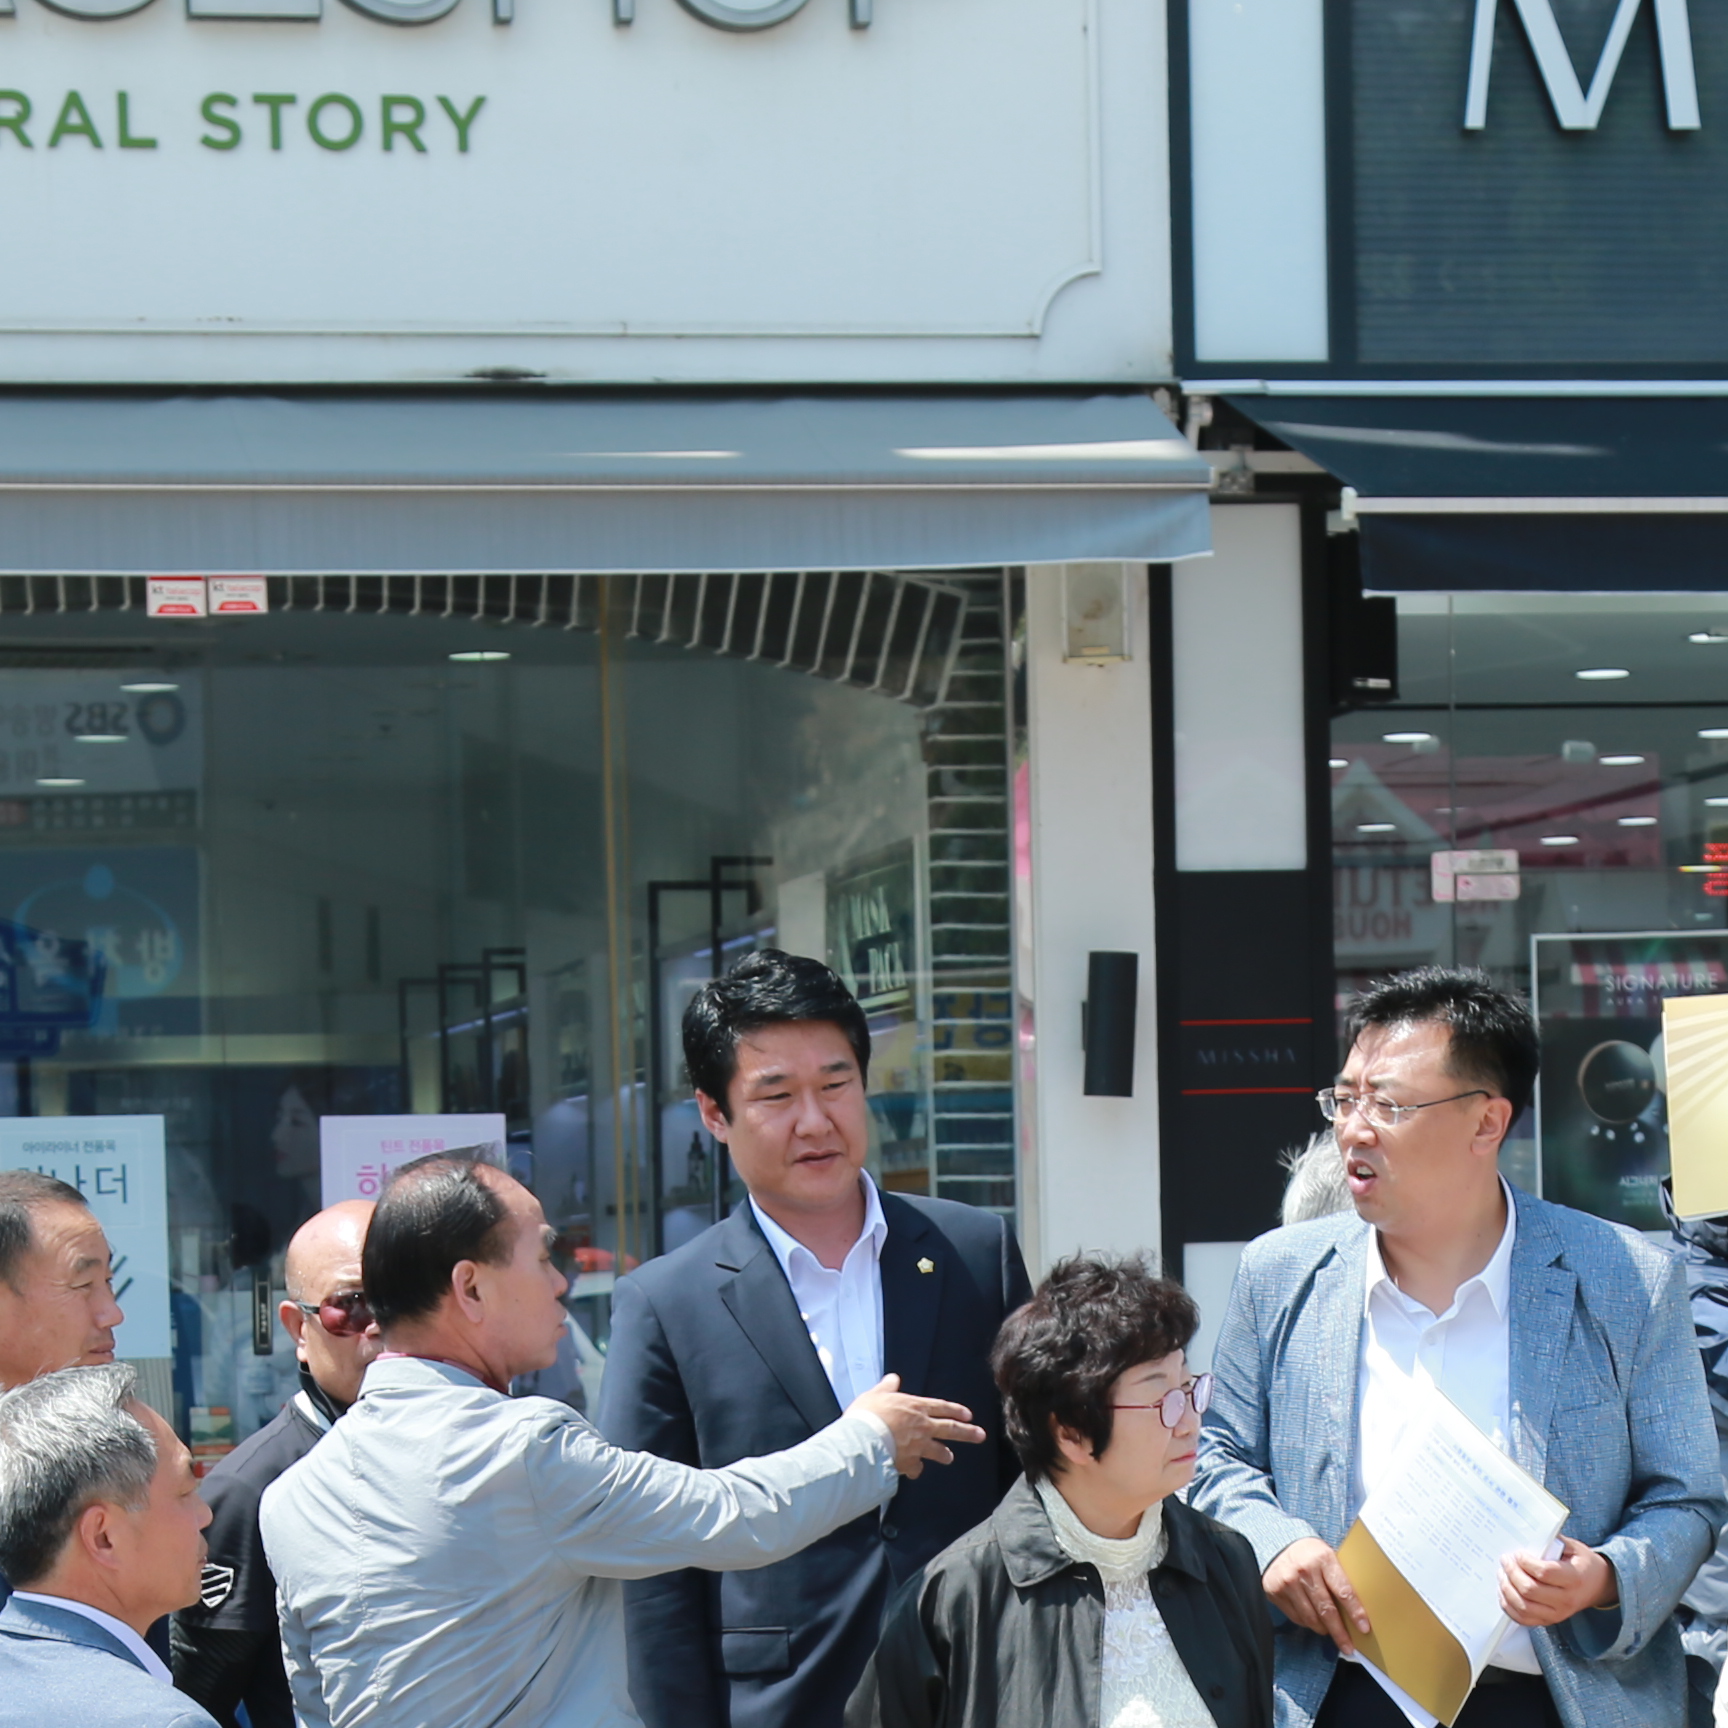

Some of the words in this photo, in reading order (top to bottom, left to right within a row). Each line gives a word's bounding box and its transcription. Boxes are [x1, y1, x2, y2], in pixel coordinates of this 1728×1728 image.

[198, 91, 488, 153] STORY
[1604, 971, 1718, 994] SIGNATURE
[94, 1163, 127, 1204] 더
